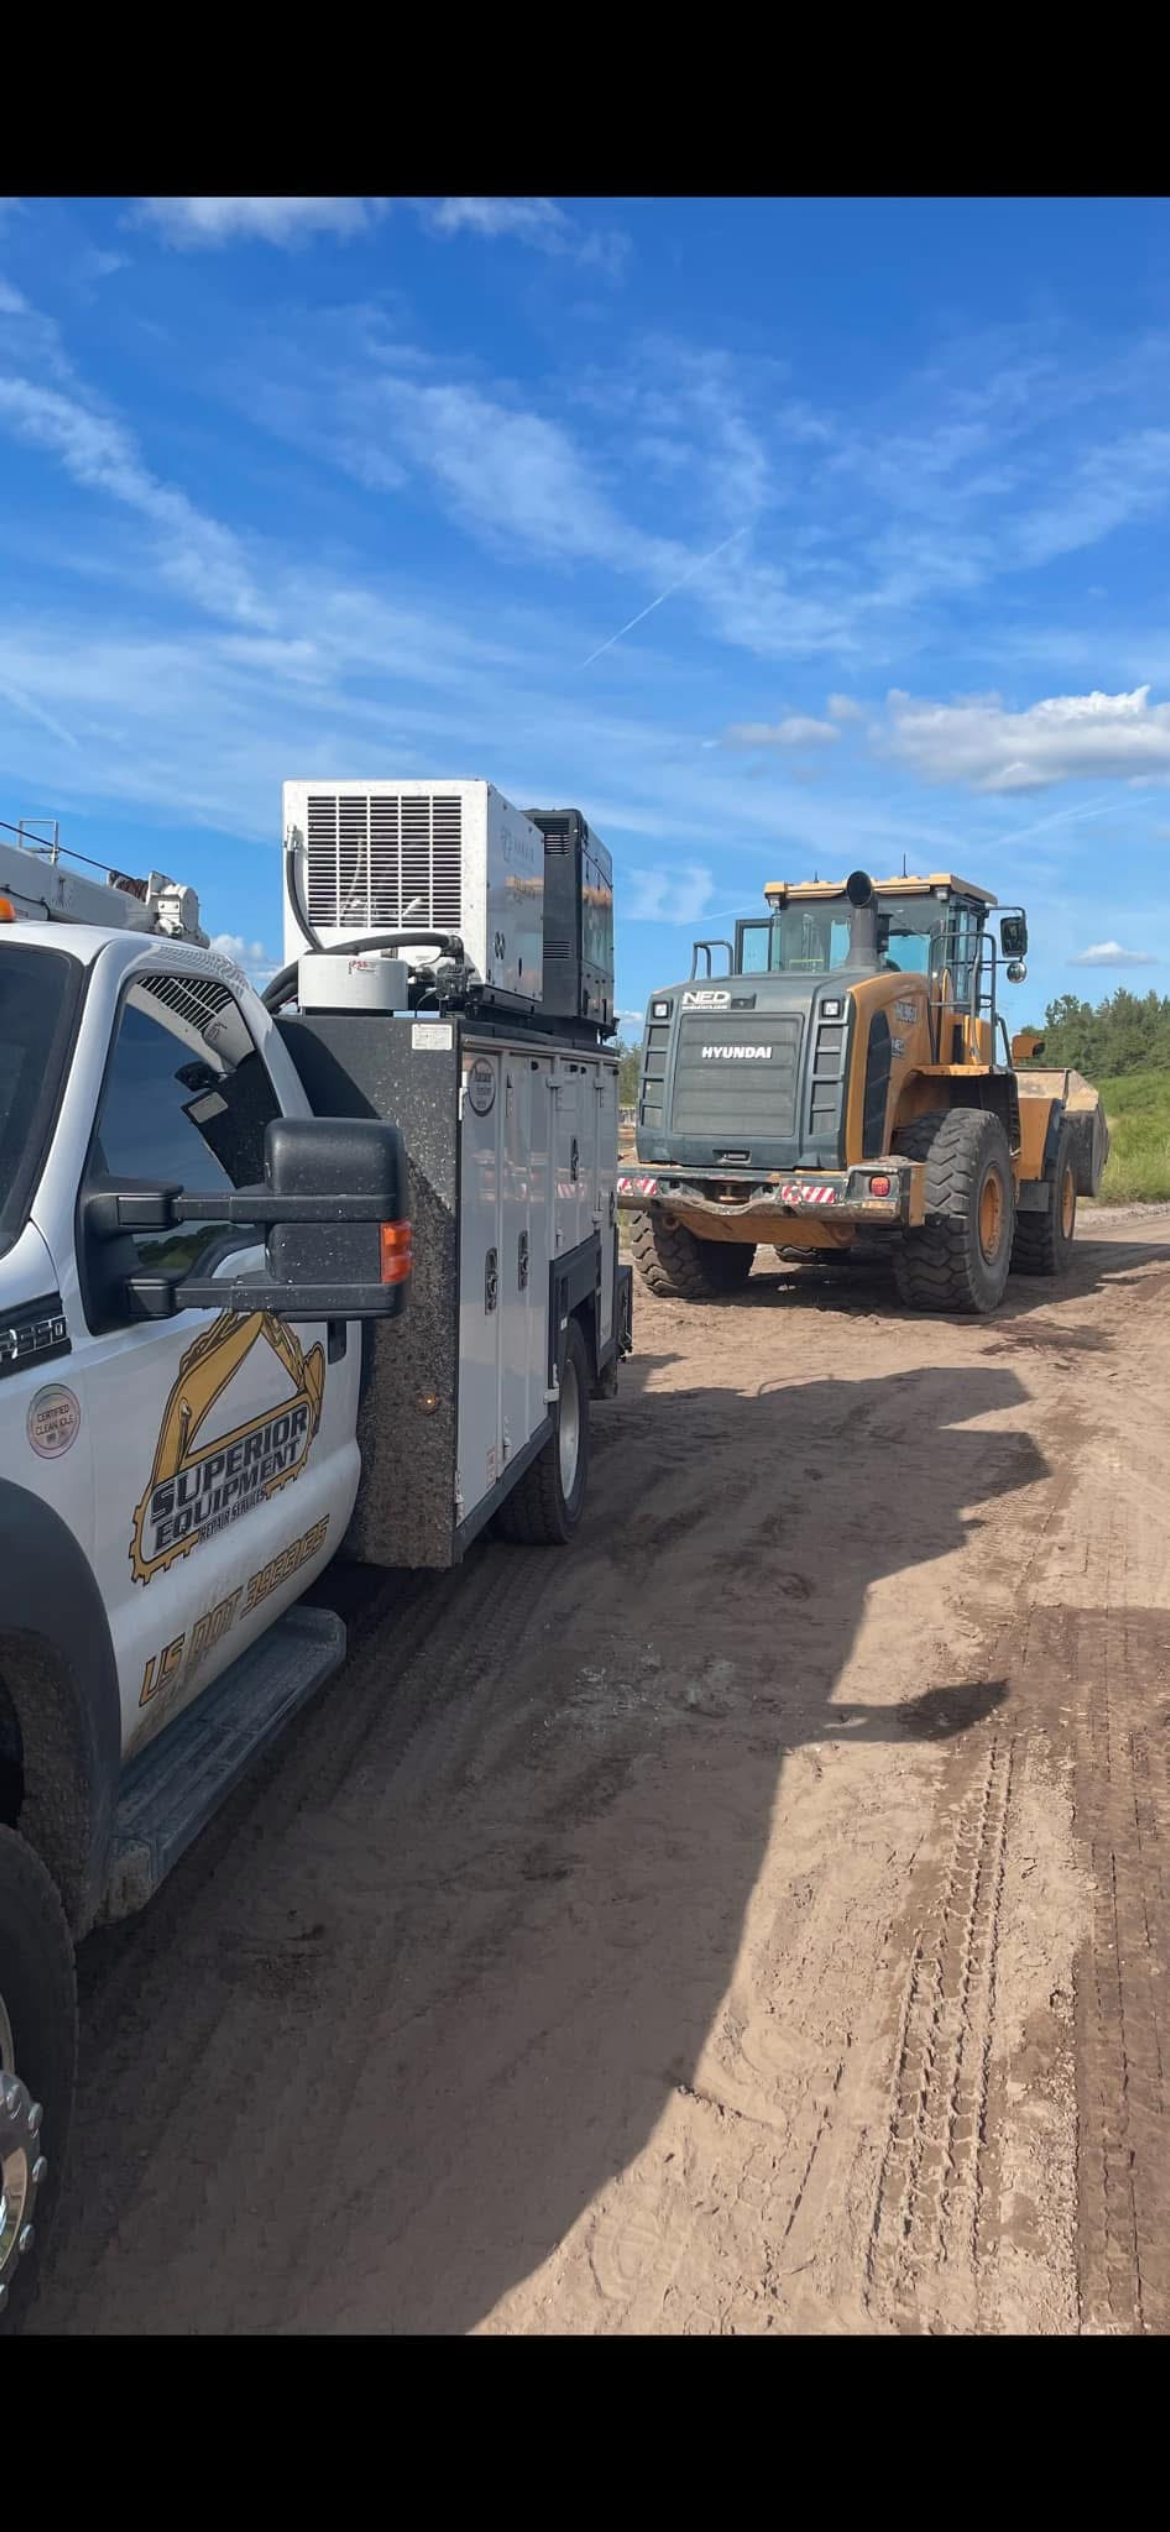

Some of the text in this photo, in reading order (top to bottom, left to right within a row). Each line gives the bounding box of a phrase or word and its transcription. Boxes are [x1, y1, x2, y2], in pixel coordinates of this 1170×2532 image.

[682, 990, 731, 1005] NED
[702, 1046, 772, 1059] HYUNDAI
[149, 1405, 308, 1526] SUPERIOR
[153, 1438, 301, 1554] EQUIPMENT
[139, 1631, 186, 1708] US
